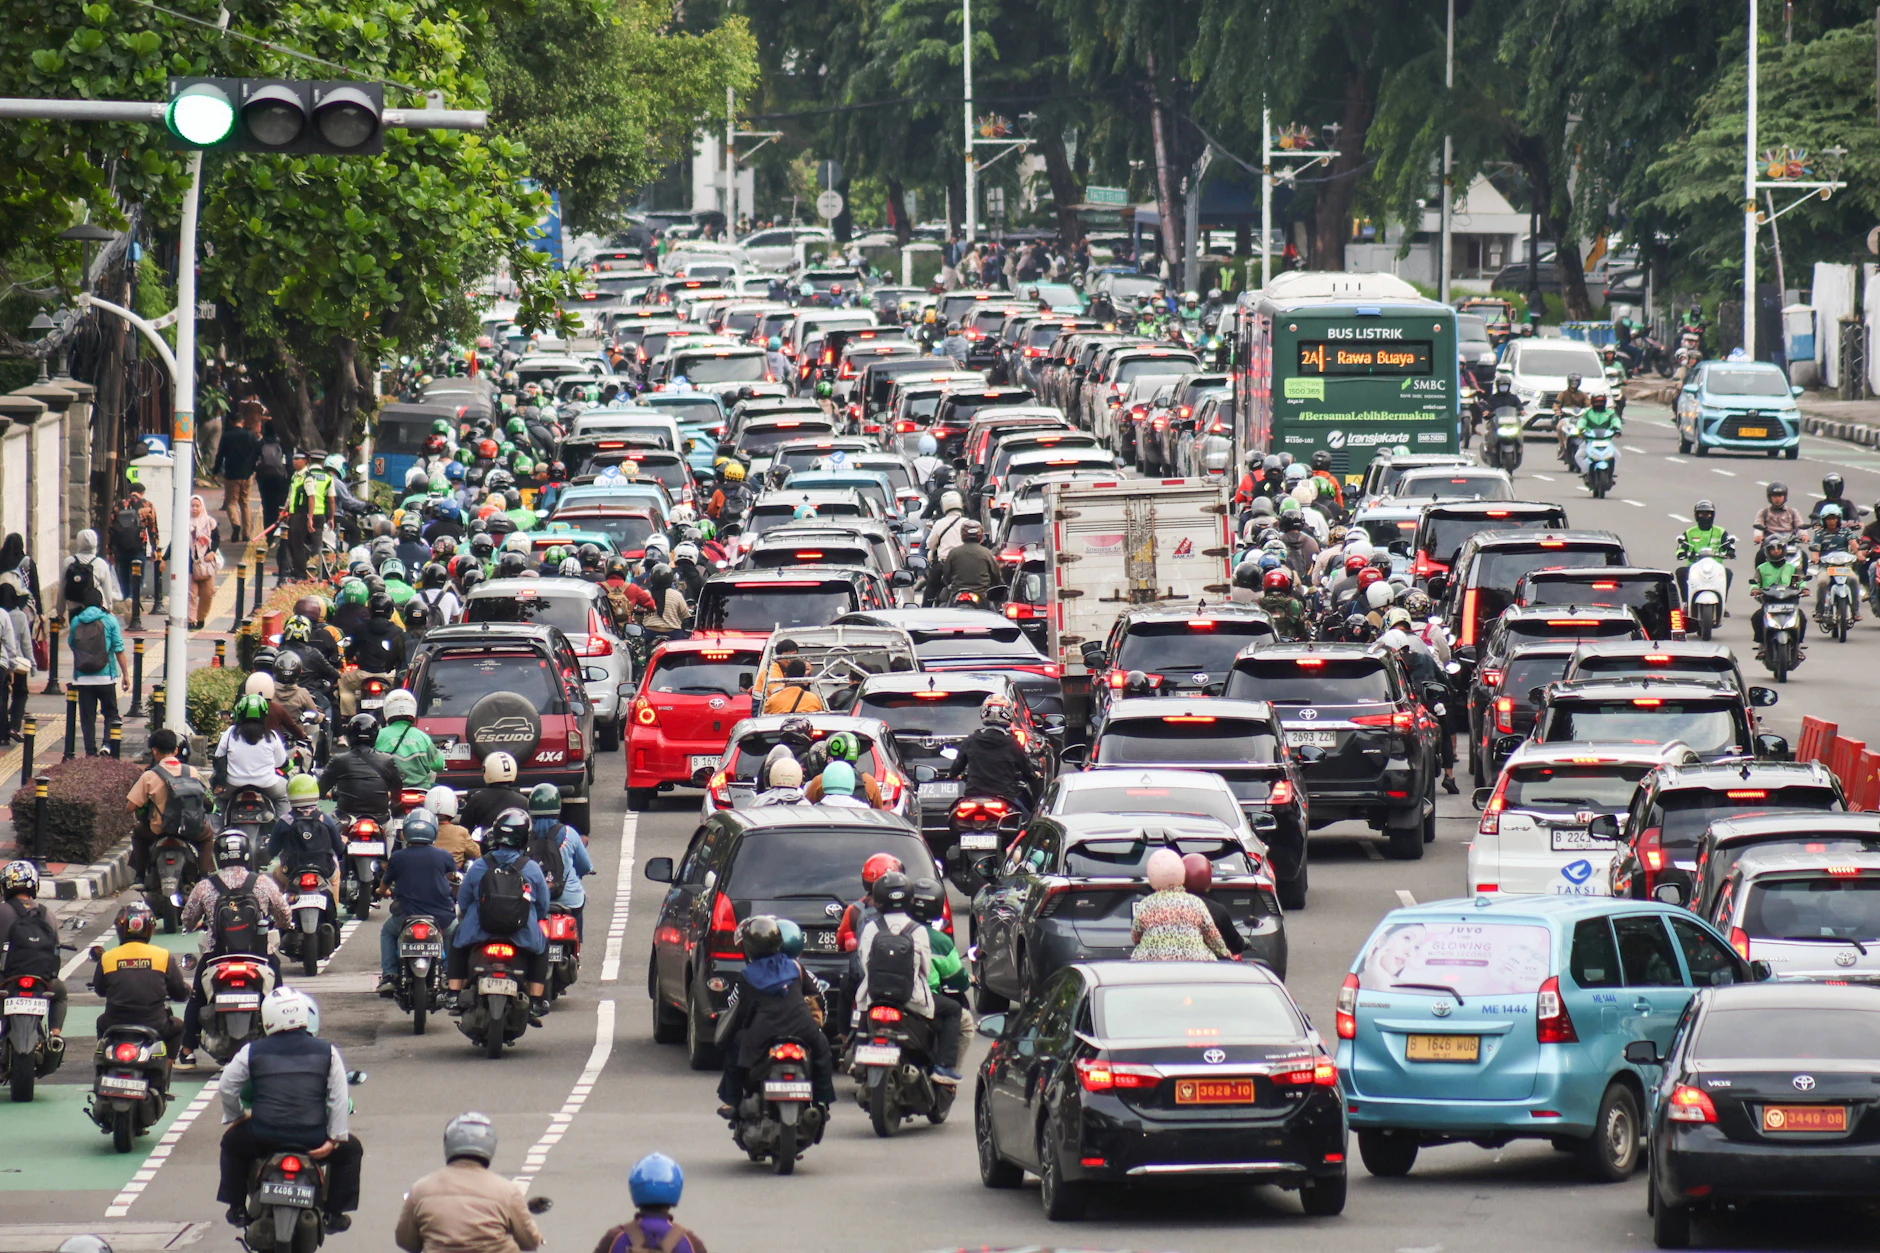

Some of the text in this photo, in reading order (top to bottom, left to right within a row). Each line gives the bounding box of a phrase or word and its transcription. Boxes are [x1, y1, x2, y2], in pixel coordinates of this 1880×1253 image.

[1327, 328, 1403, 339] BUS LISTRIK
[1337, 350, 1373, 365] Rawa
[1376, 350, 1415, 367] Buaya
[1413, 379, 1446, 391] SMBC
[1298, 411, 1436, 421] #BersamaLebihBermakna
[1346, 432, 1410, 446] transjakarta
[346, 586, 363, 595] Grab
[475, 733, 535, 742] ESCUDO
[1292, 732, 1336, 742] 2693 ZZH
[535, 751, 563, 762] 4X4
[693, 757, 699, 767] B
[941, 783, 959, 794] HER
[1555, 832, 1562, 843] B
[1556, 886, 1596, 894] TAKSI
[1449, 926, 1483, 935] juva
[1432, 941, 1493, 951] GLOWING
[118, 958, 151, 967] mxim
[1481, 1005, 1528, 1014] ME 1446
[1410, 1038, 1478, 1051] B 1646 WUB
[264, 1184, 312, 1199] B 4406 TNH
